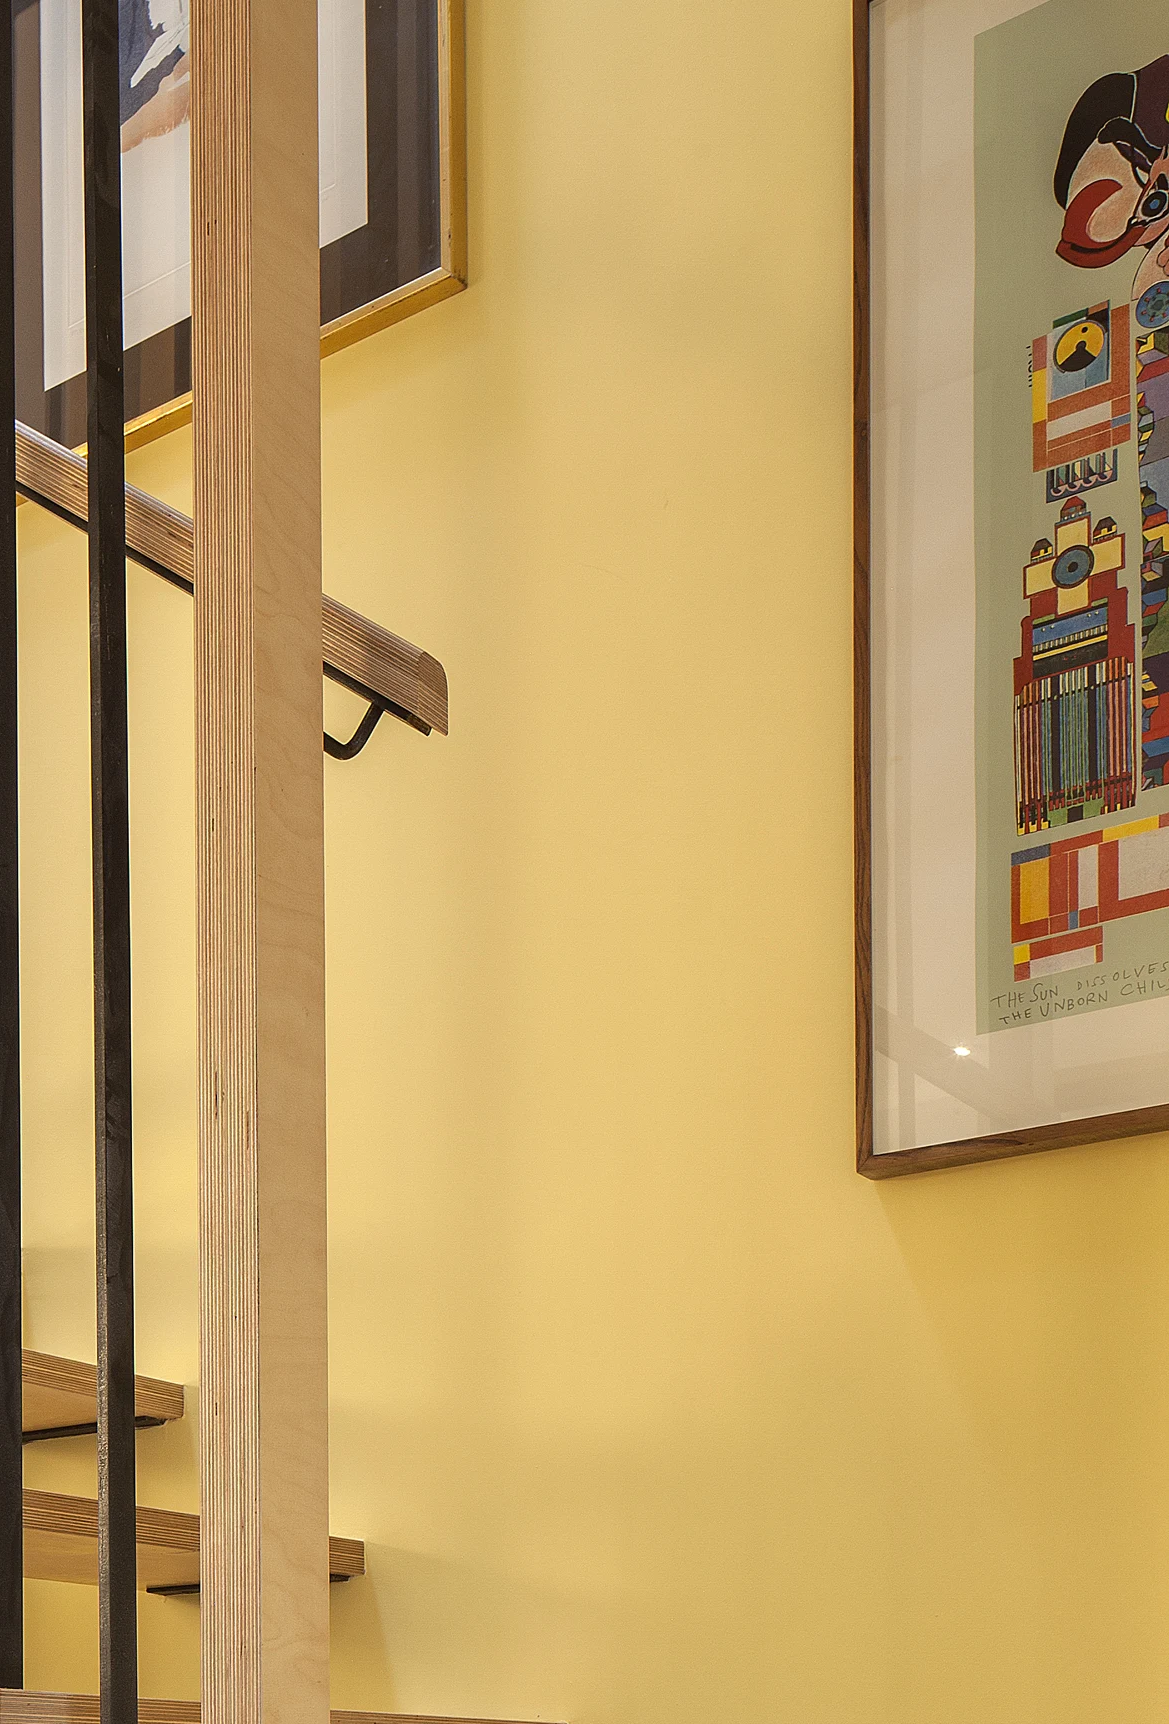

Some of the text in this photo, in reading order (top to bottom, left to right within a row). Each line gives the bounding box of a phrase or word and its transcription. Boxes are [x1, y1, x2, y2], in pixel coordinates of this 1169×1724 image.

[990, 961, 1169, 1008] THE SUN DISSOLVES
[998, 979, 1169, 1025] THE UNBORN CHIL
